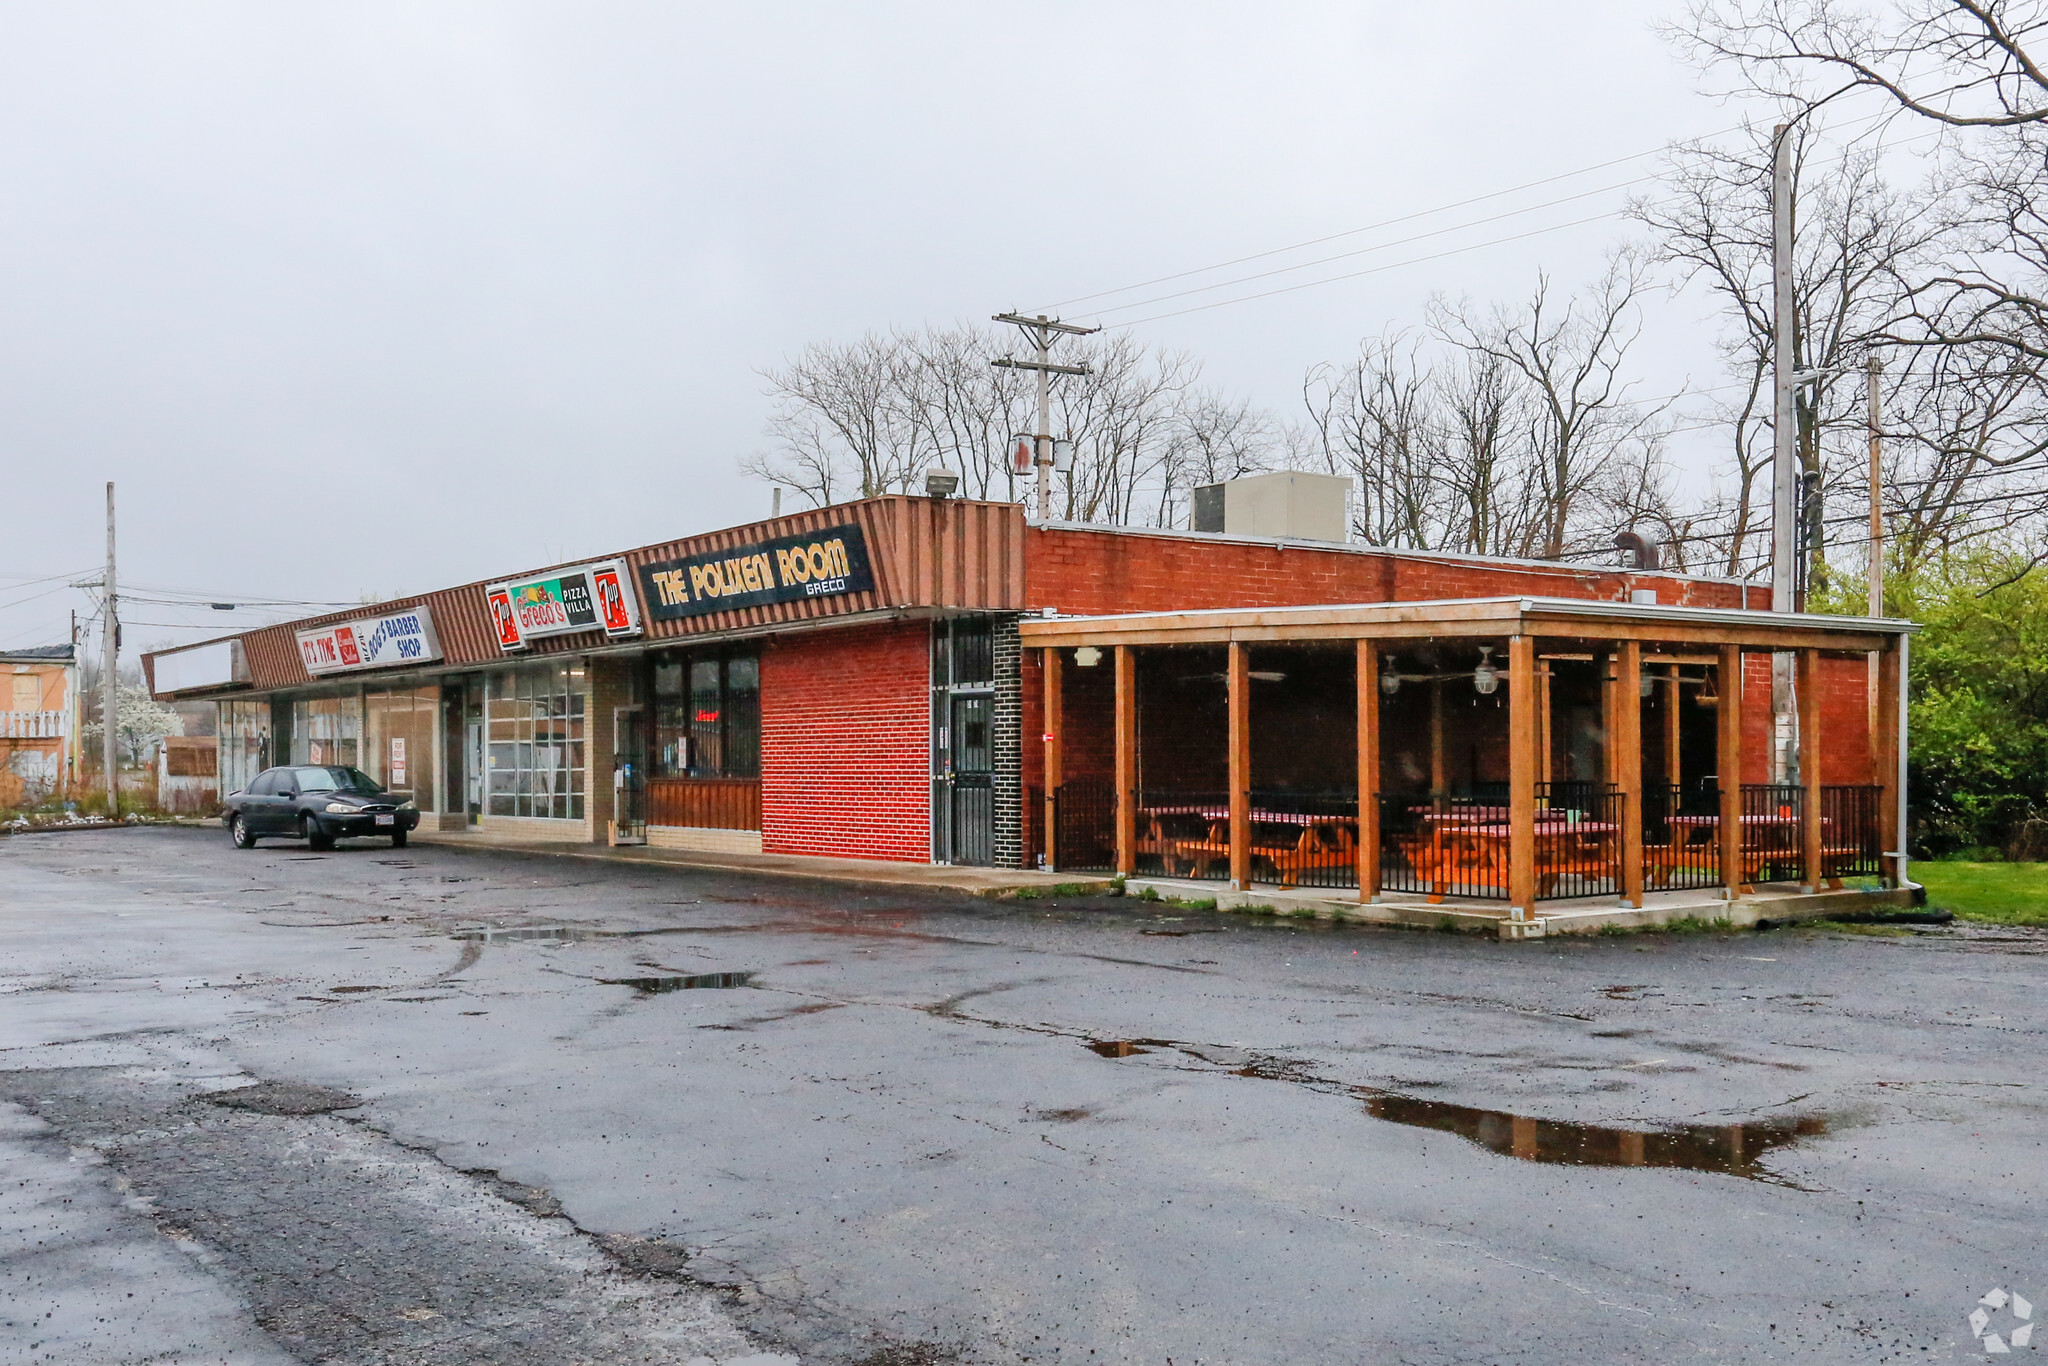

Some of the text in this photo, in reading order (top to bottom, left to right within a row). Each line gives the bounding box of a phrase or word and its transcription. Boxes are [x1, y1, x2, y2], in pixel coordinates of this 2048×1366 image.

[652, 568, 689, 606] THE
[776, 538, 850, 586] ROOM
[563, 586, 588, 601] PIZZA
[805, 578, 846, 595] GRECO
[516, 591, 565, 629] Greco's
[565, 599, 592, 614] VILLA
[385, 615, 422, 638] BARBER
[397, 637, 421, 658] SHOP
